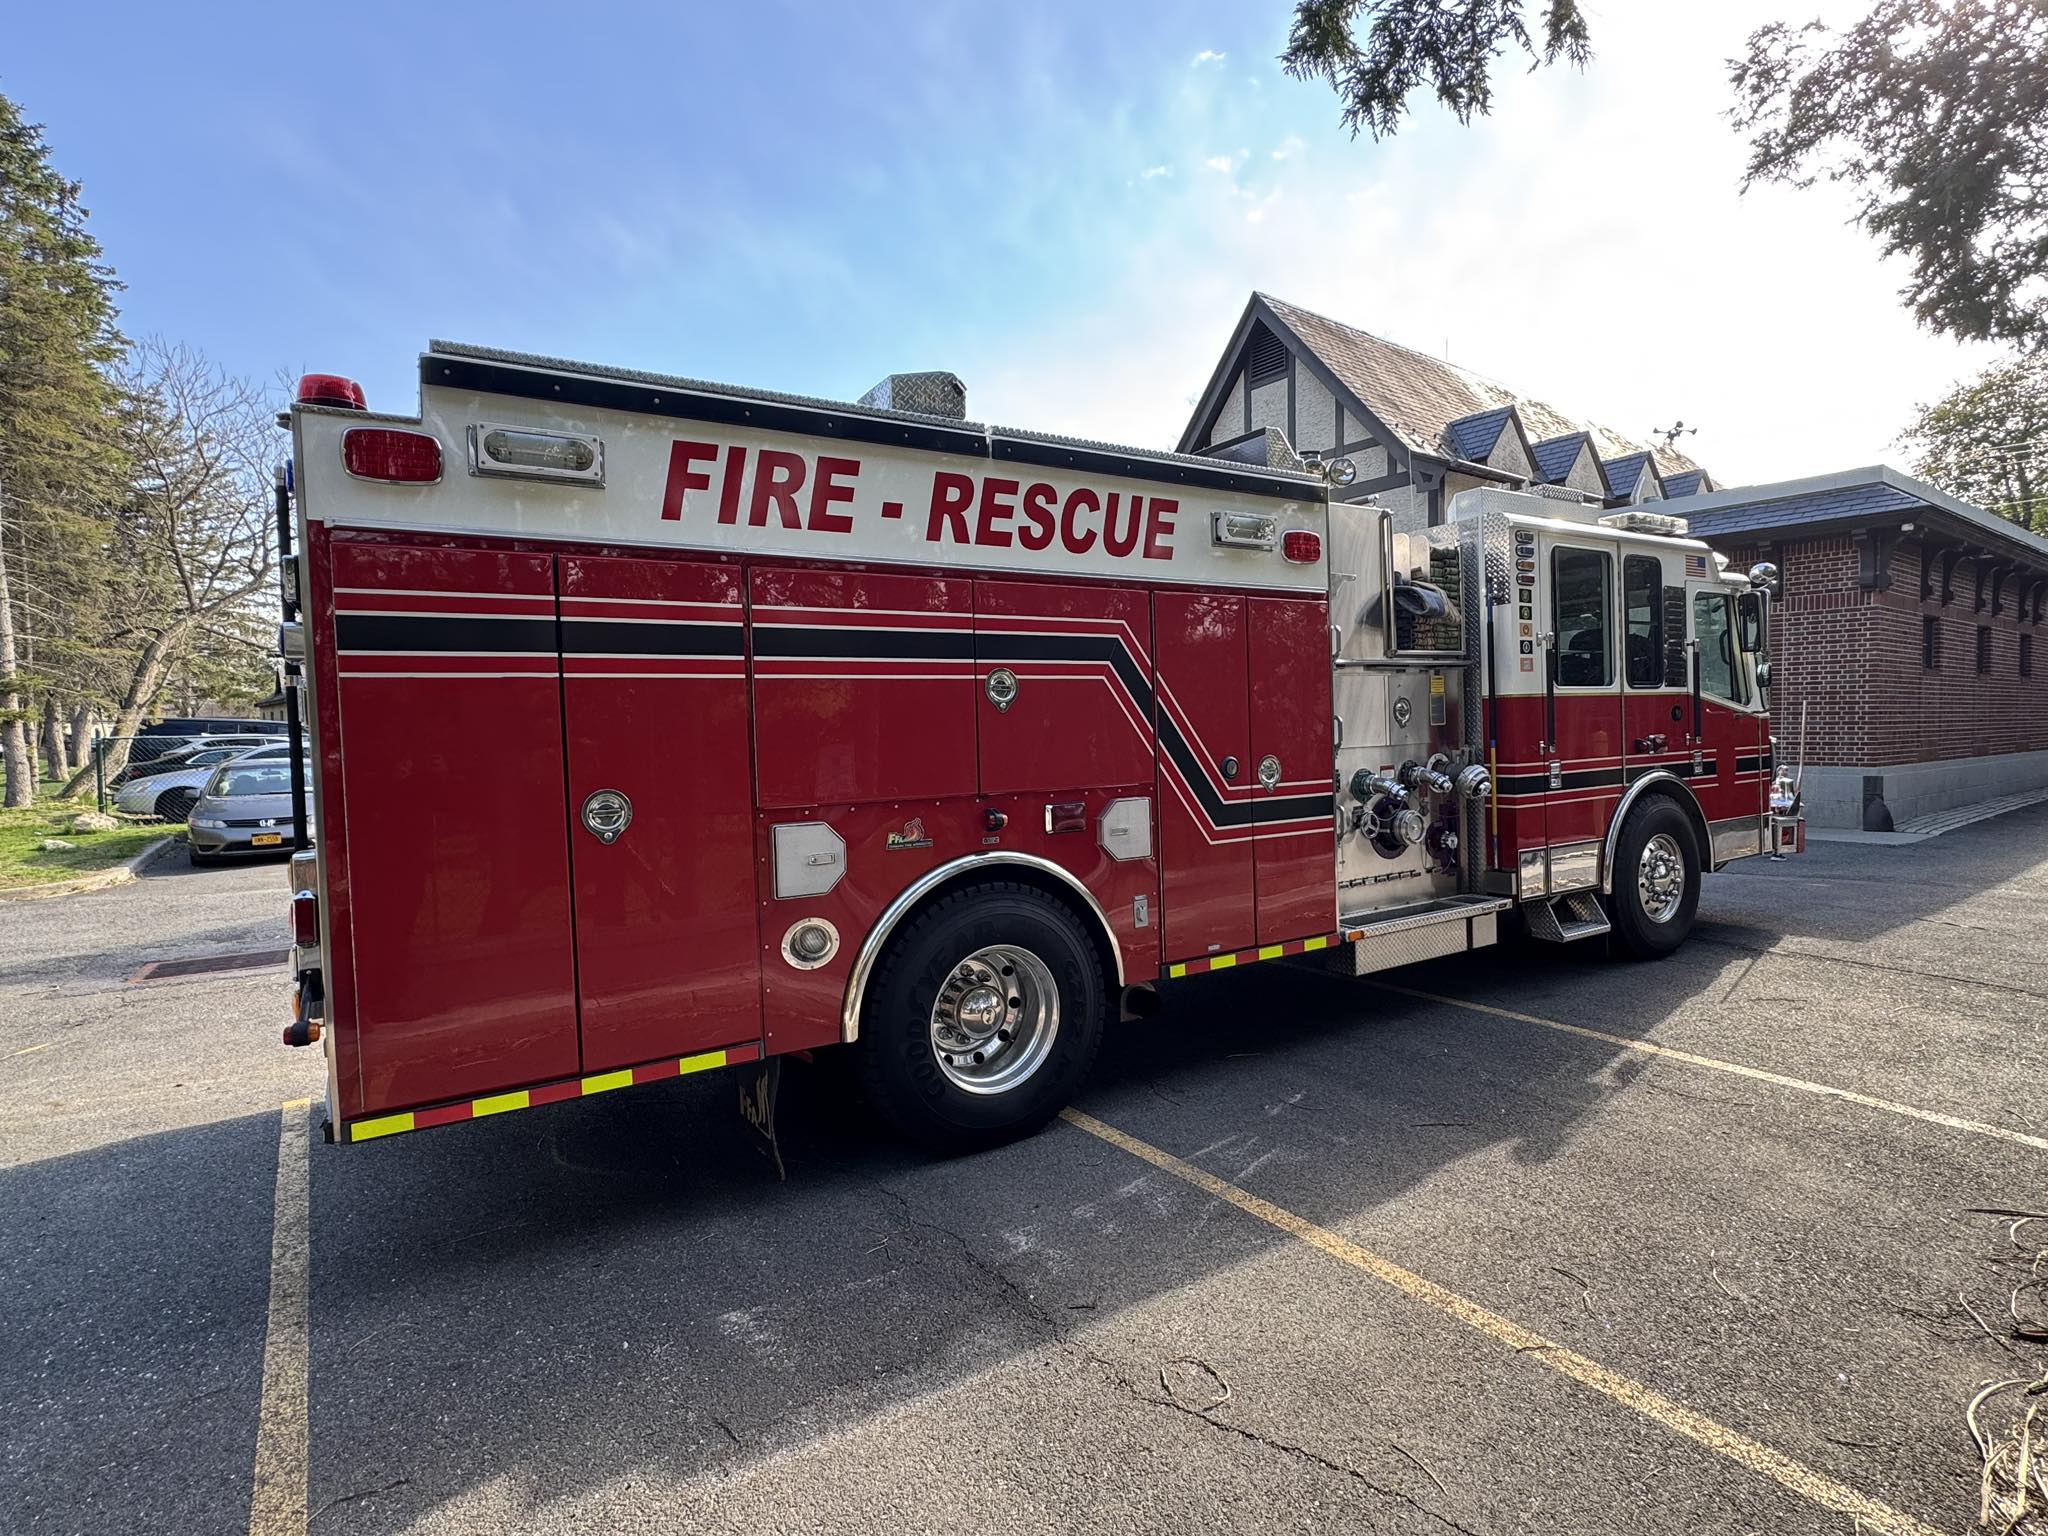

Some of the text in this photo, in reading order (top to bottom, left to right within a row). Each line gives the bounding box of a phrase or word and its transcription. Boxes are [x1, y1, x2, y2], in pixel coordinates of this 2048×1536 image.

[661, 439, 1179, 561] FIRE - RESCUE
